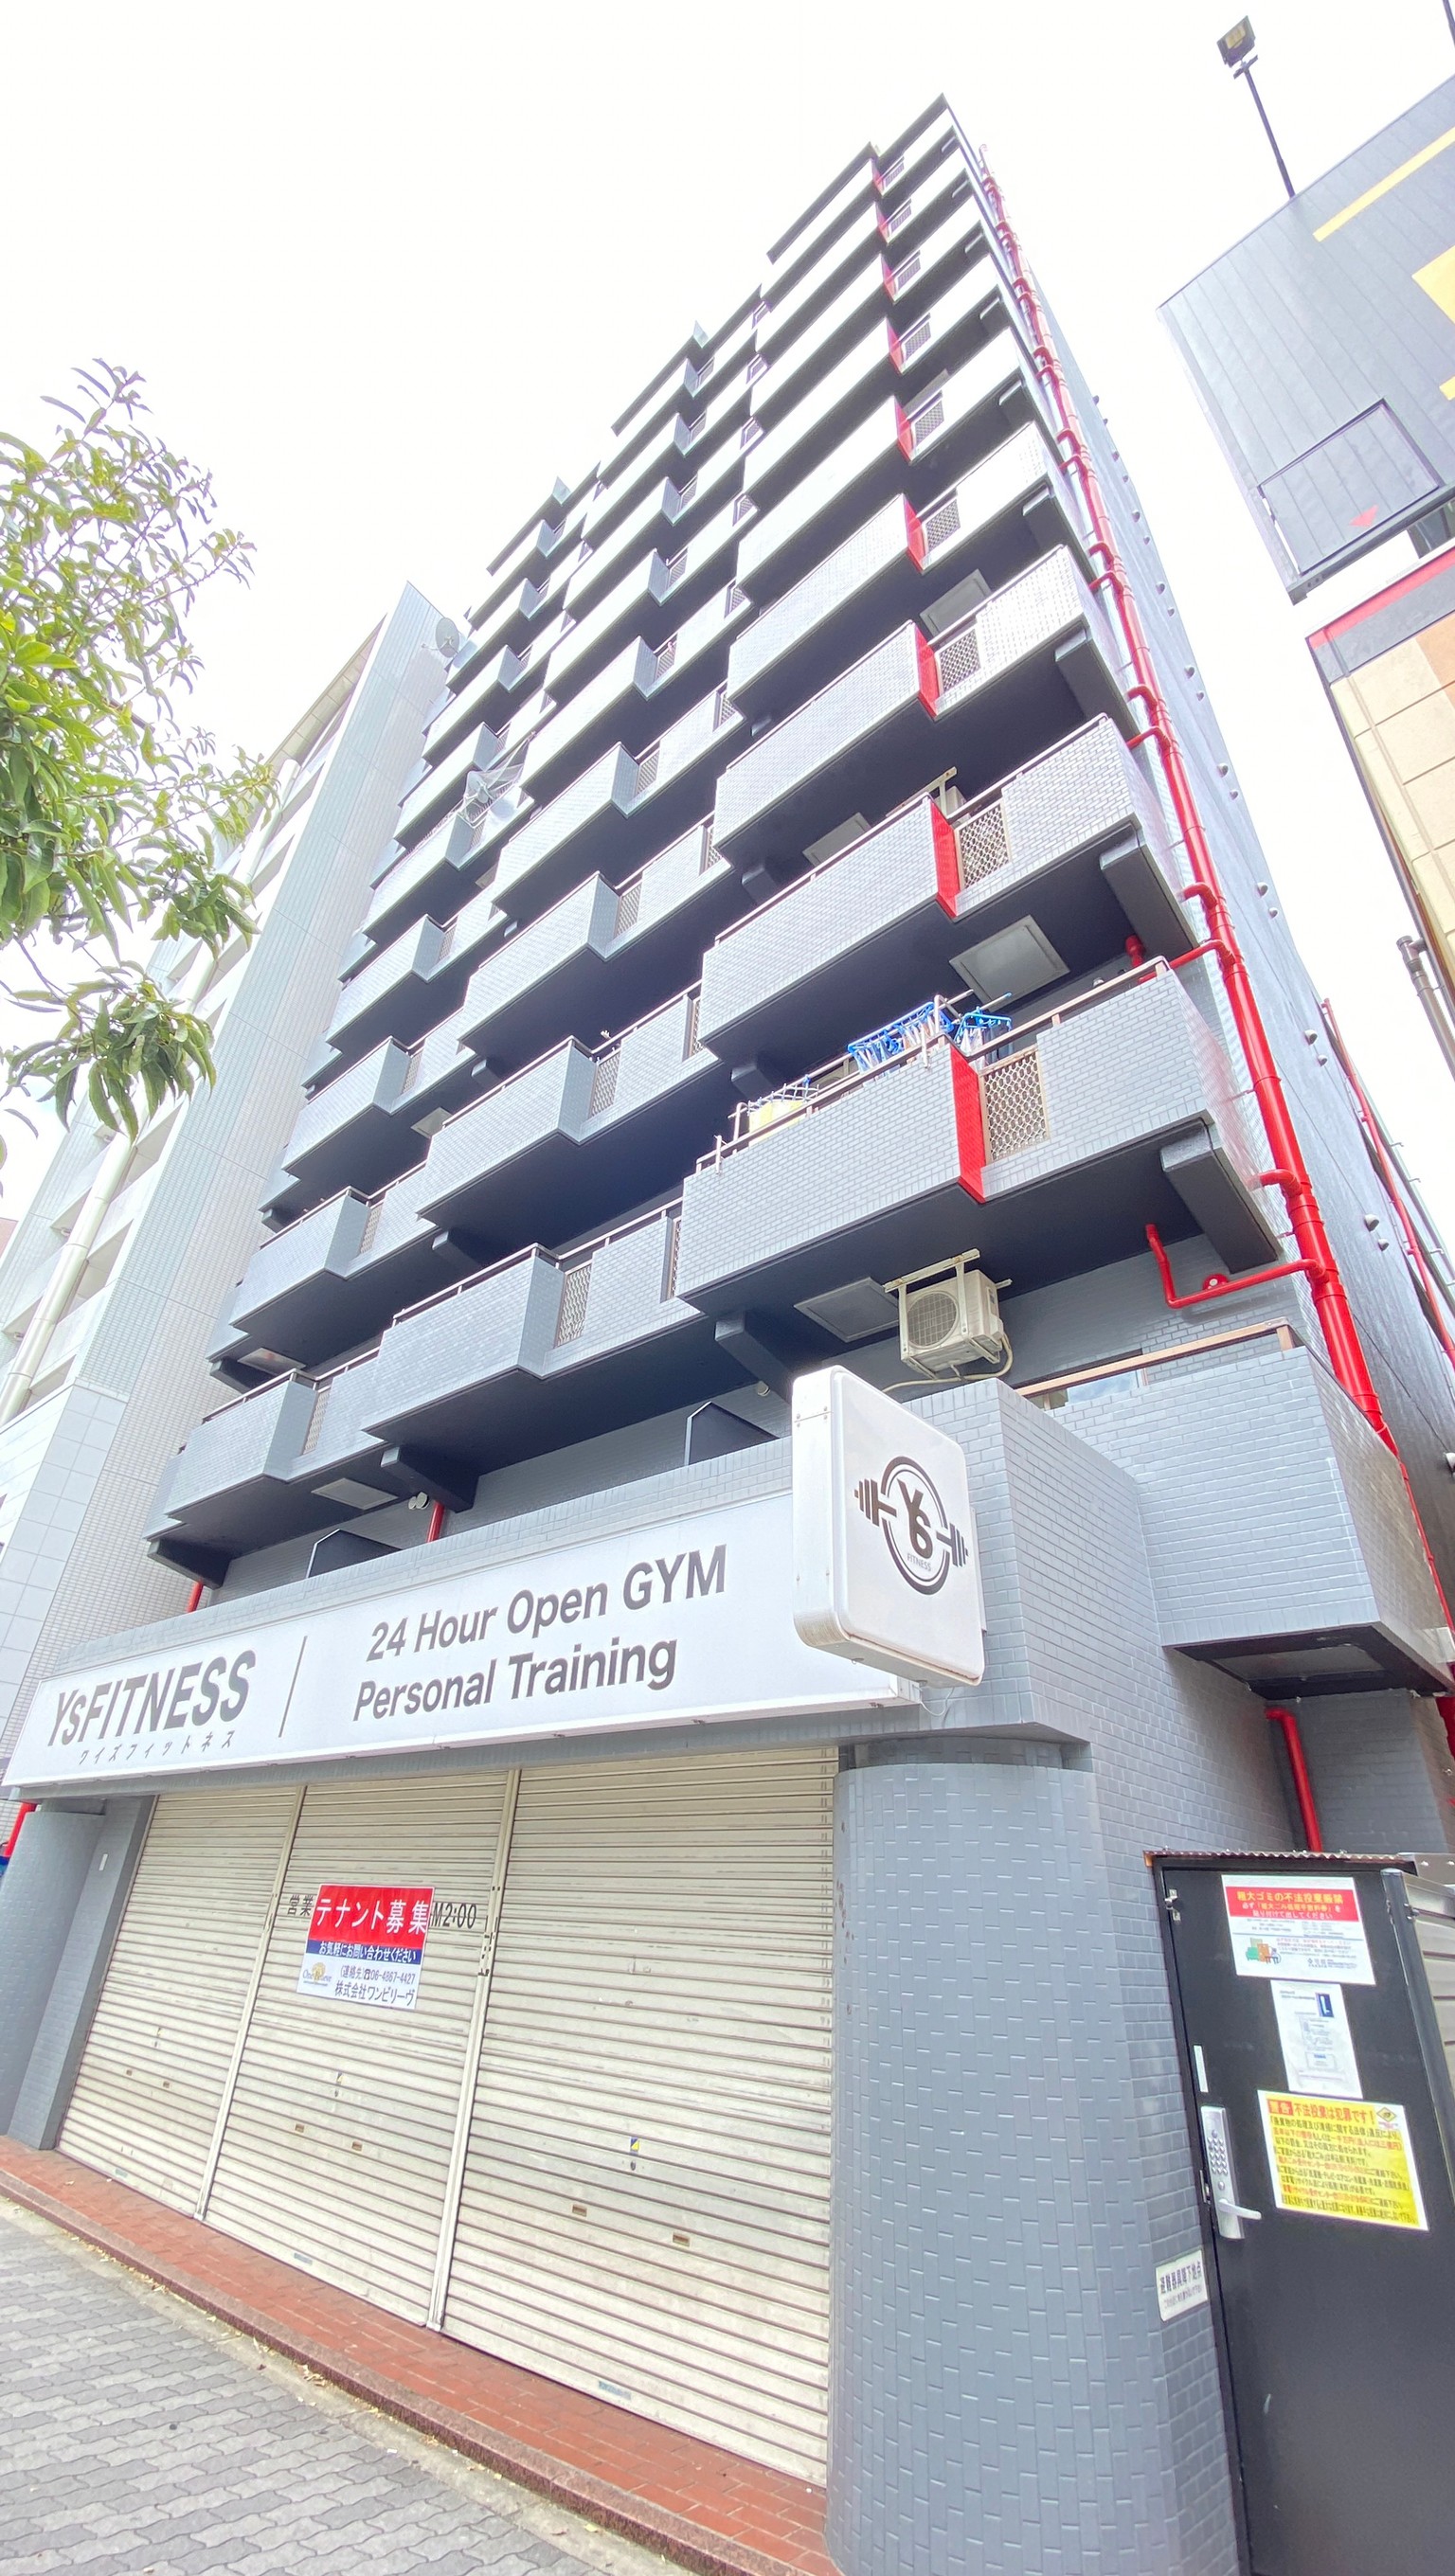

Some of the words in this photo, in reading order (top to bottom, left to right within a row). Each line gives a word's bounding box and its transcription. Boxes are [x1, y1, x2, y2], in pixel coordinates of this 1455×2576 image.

[907, 1553, 931, 1572] FITNESS
[366, 1618, 408, 1662] 24
[414, 1606, 498, 1654] Hour
[507, 1583, 608, 1638] Open
[622, 1544, 727, 1611] GYM
[352, 1659, 496, 1722] Personal
[508, 1637, 677, 1700] Training
[79, 1730, 235, 1765] ワイズフィットネス
[287, 1894, 314, 1917] 営業
[315, 1898, 429, 1935] テナント募集
[318, 1941, 416, 1964] お気軽にお問い合わせください
